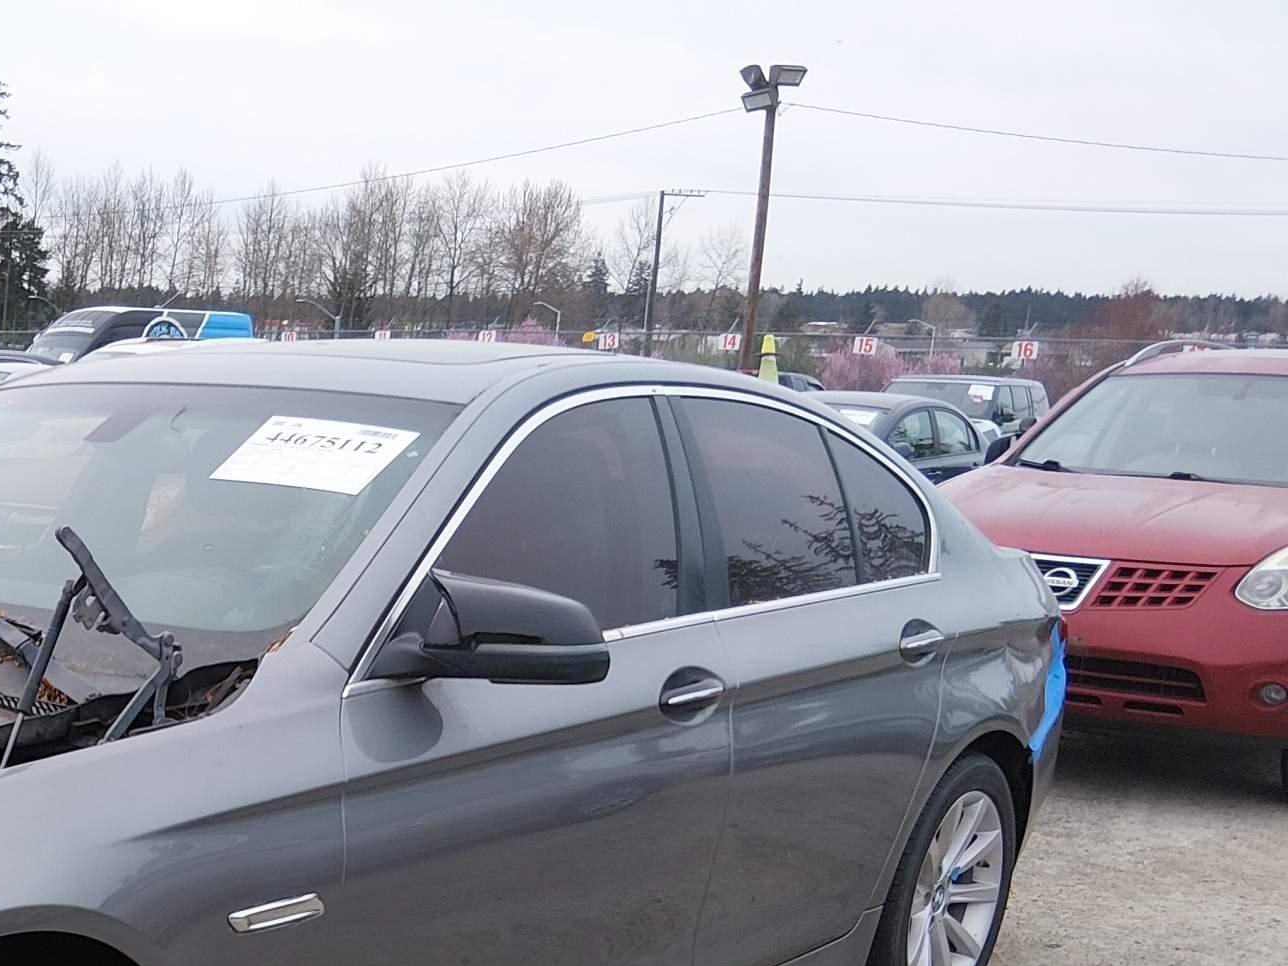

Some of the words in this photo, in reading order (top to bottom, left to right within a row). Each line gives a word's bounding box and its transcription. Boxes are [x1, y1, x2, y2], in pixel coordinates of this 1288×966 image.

[603, 334, 616, 348] 13
[723, 335, 737, 349] 14
[858, 339, 873, 353] 15
[1017, 342, 1033, 358] 16
[266, 431, 383, 454] 44675112
